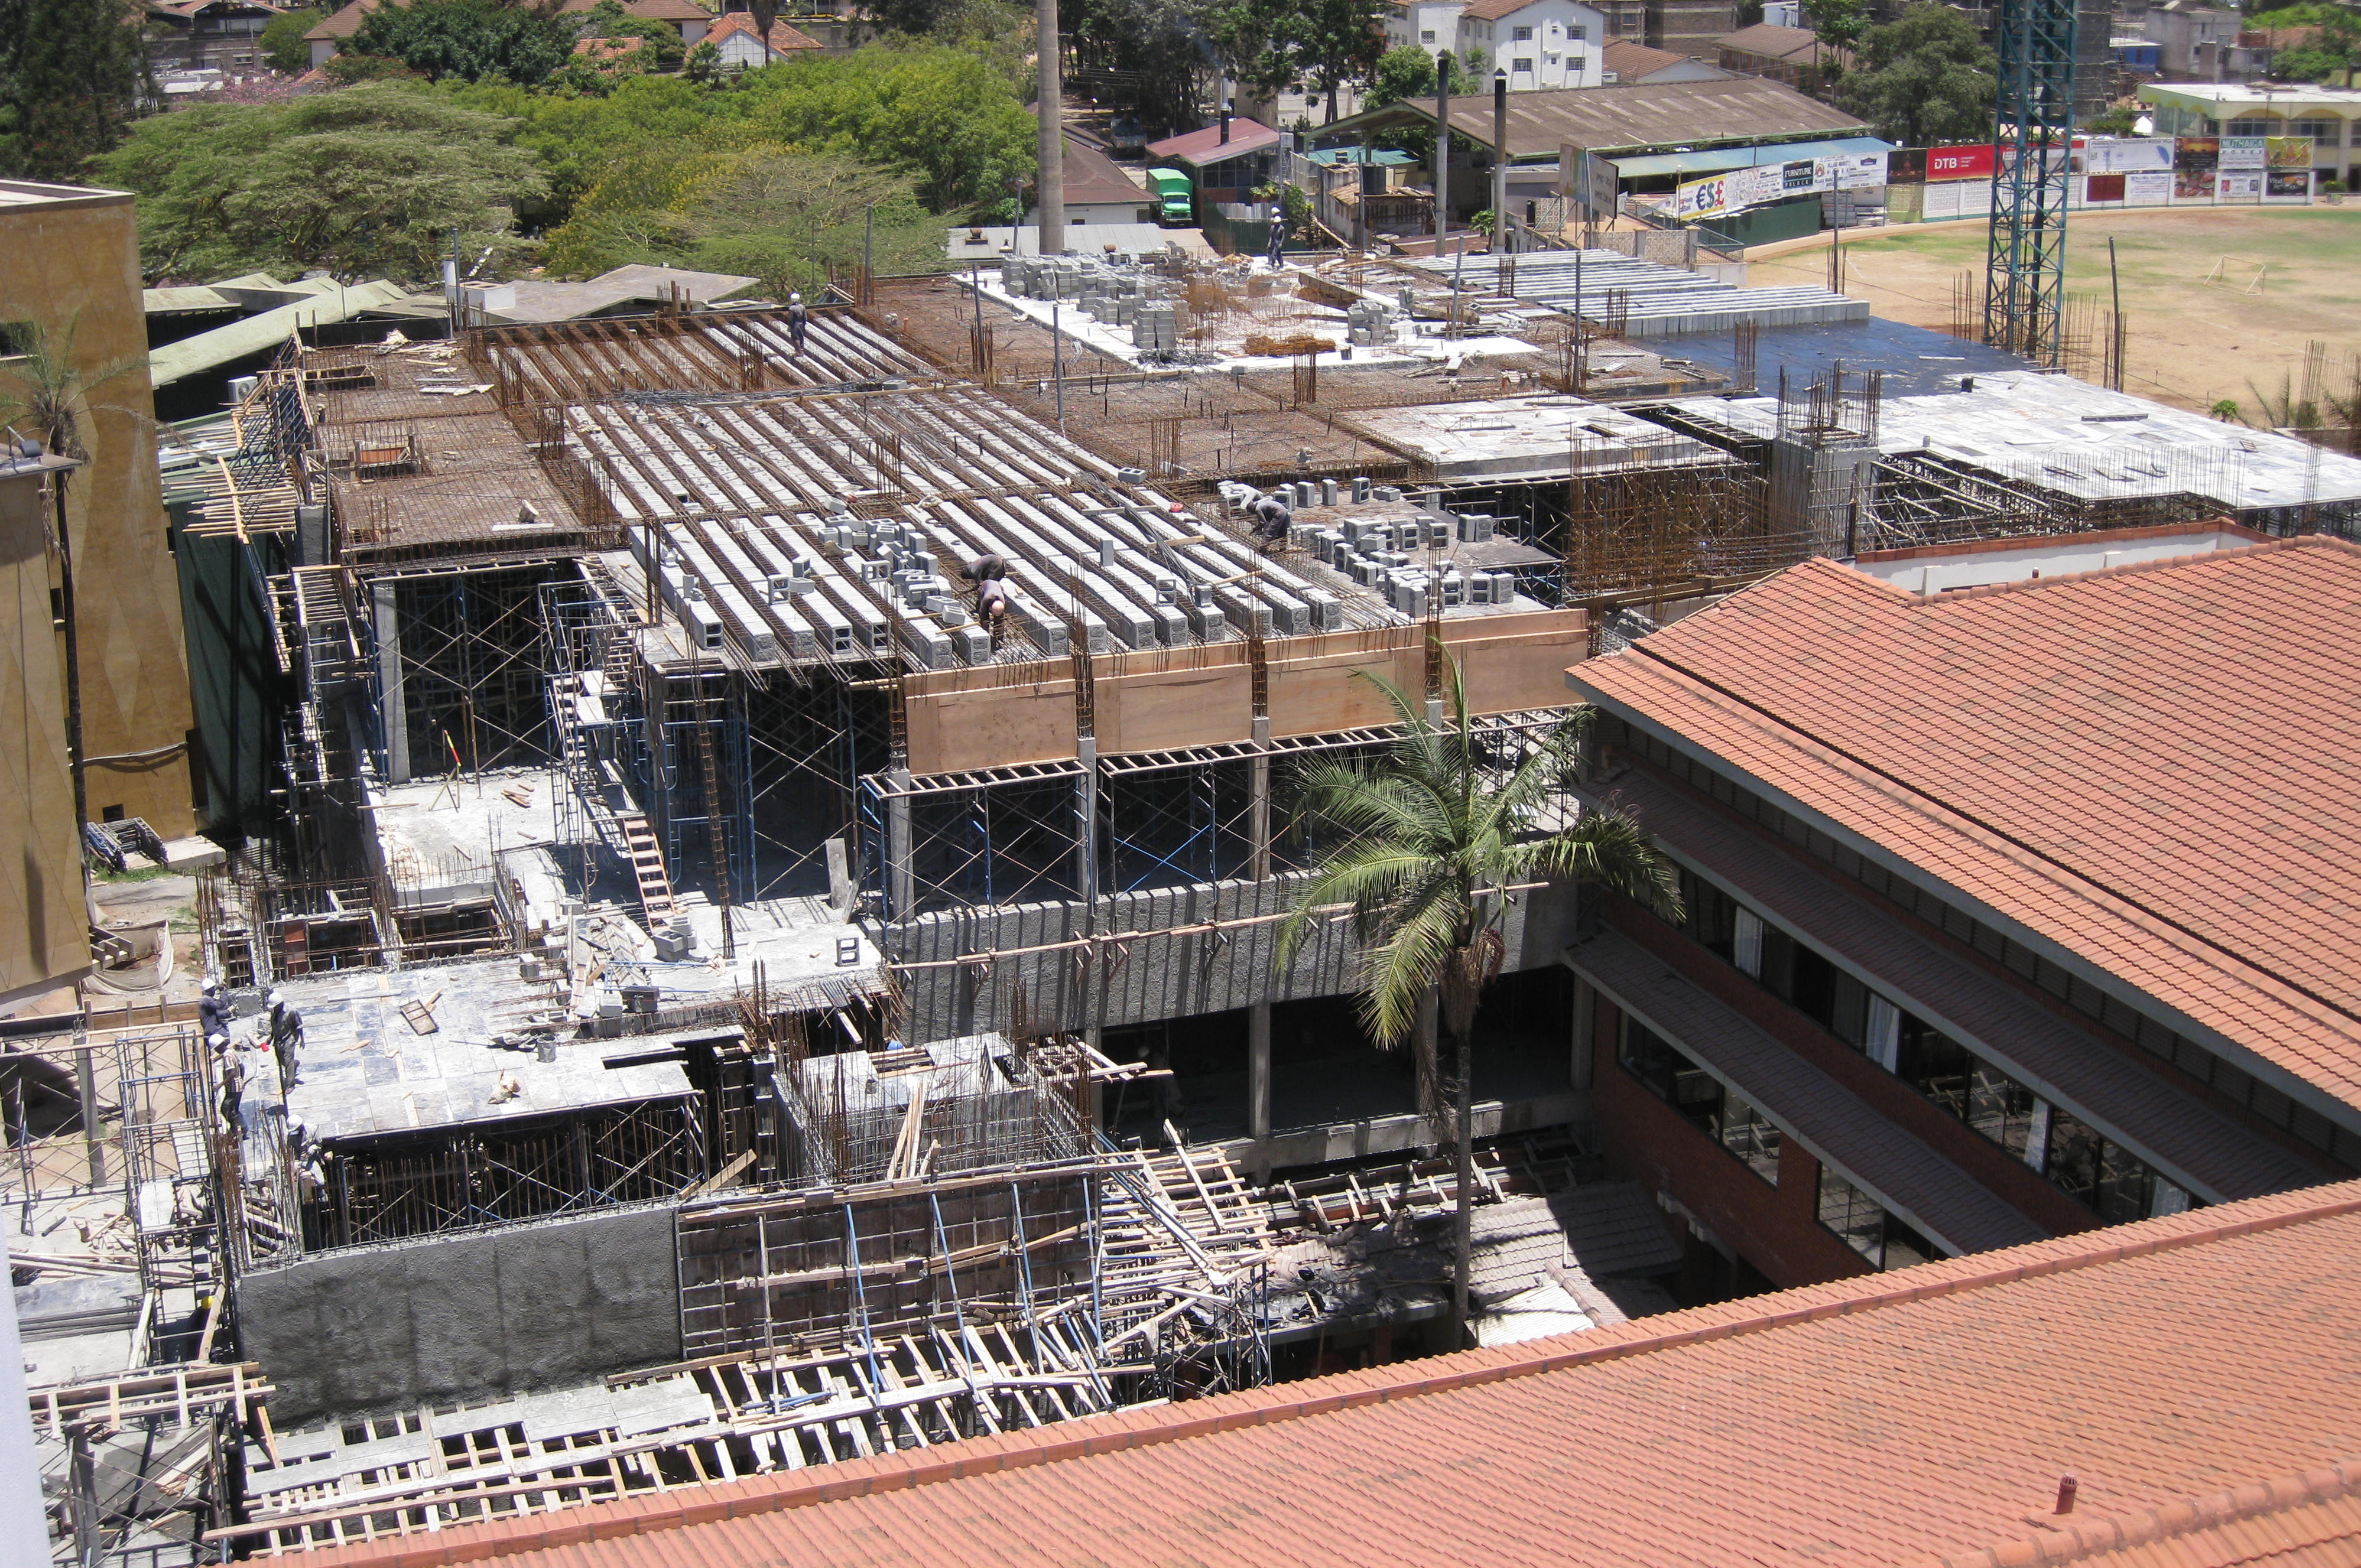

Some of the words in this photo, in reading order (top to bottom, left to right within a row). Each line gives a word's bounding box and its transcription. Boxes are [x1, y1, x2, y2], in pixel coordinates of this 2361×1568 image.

[2222, 139, 2263, 148] MUTHAIGA
[1934, 158, 1957, 170] DTB
[1785, 167, 1812, 177] FURNITURE
